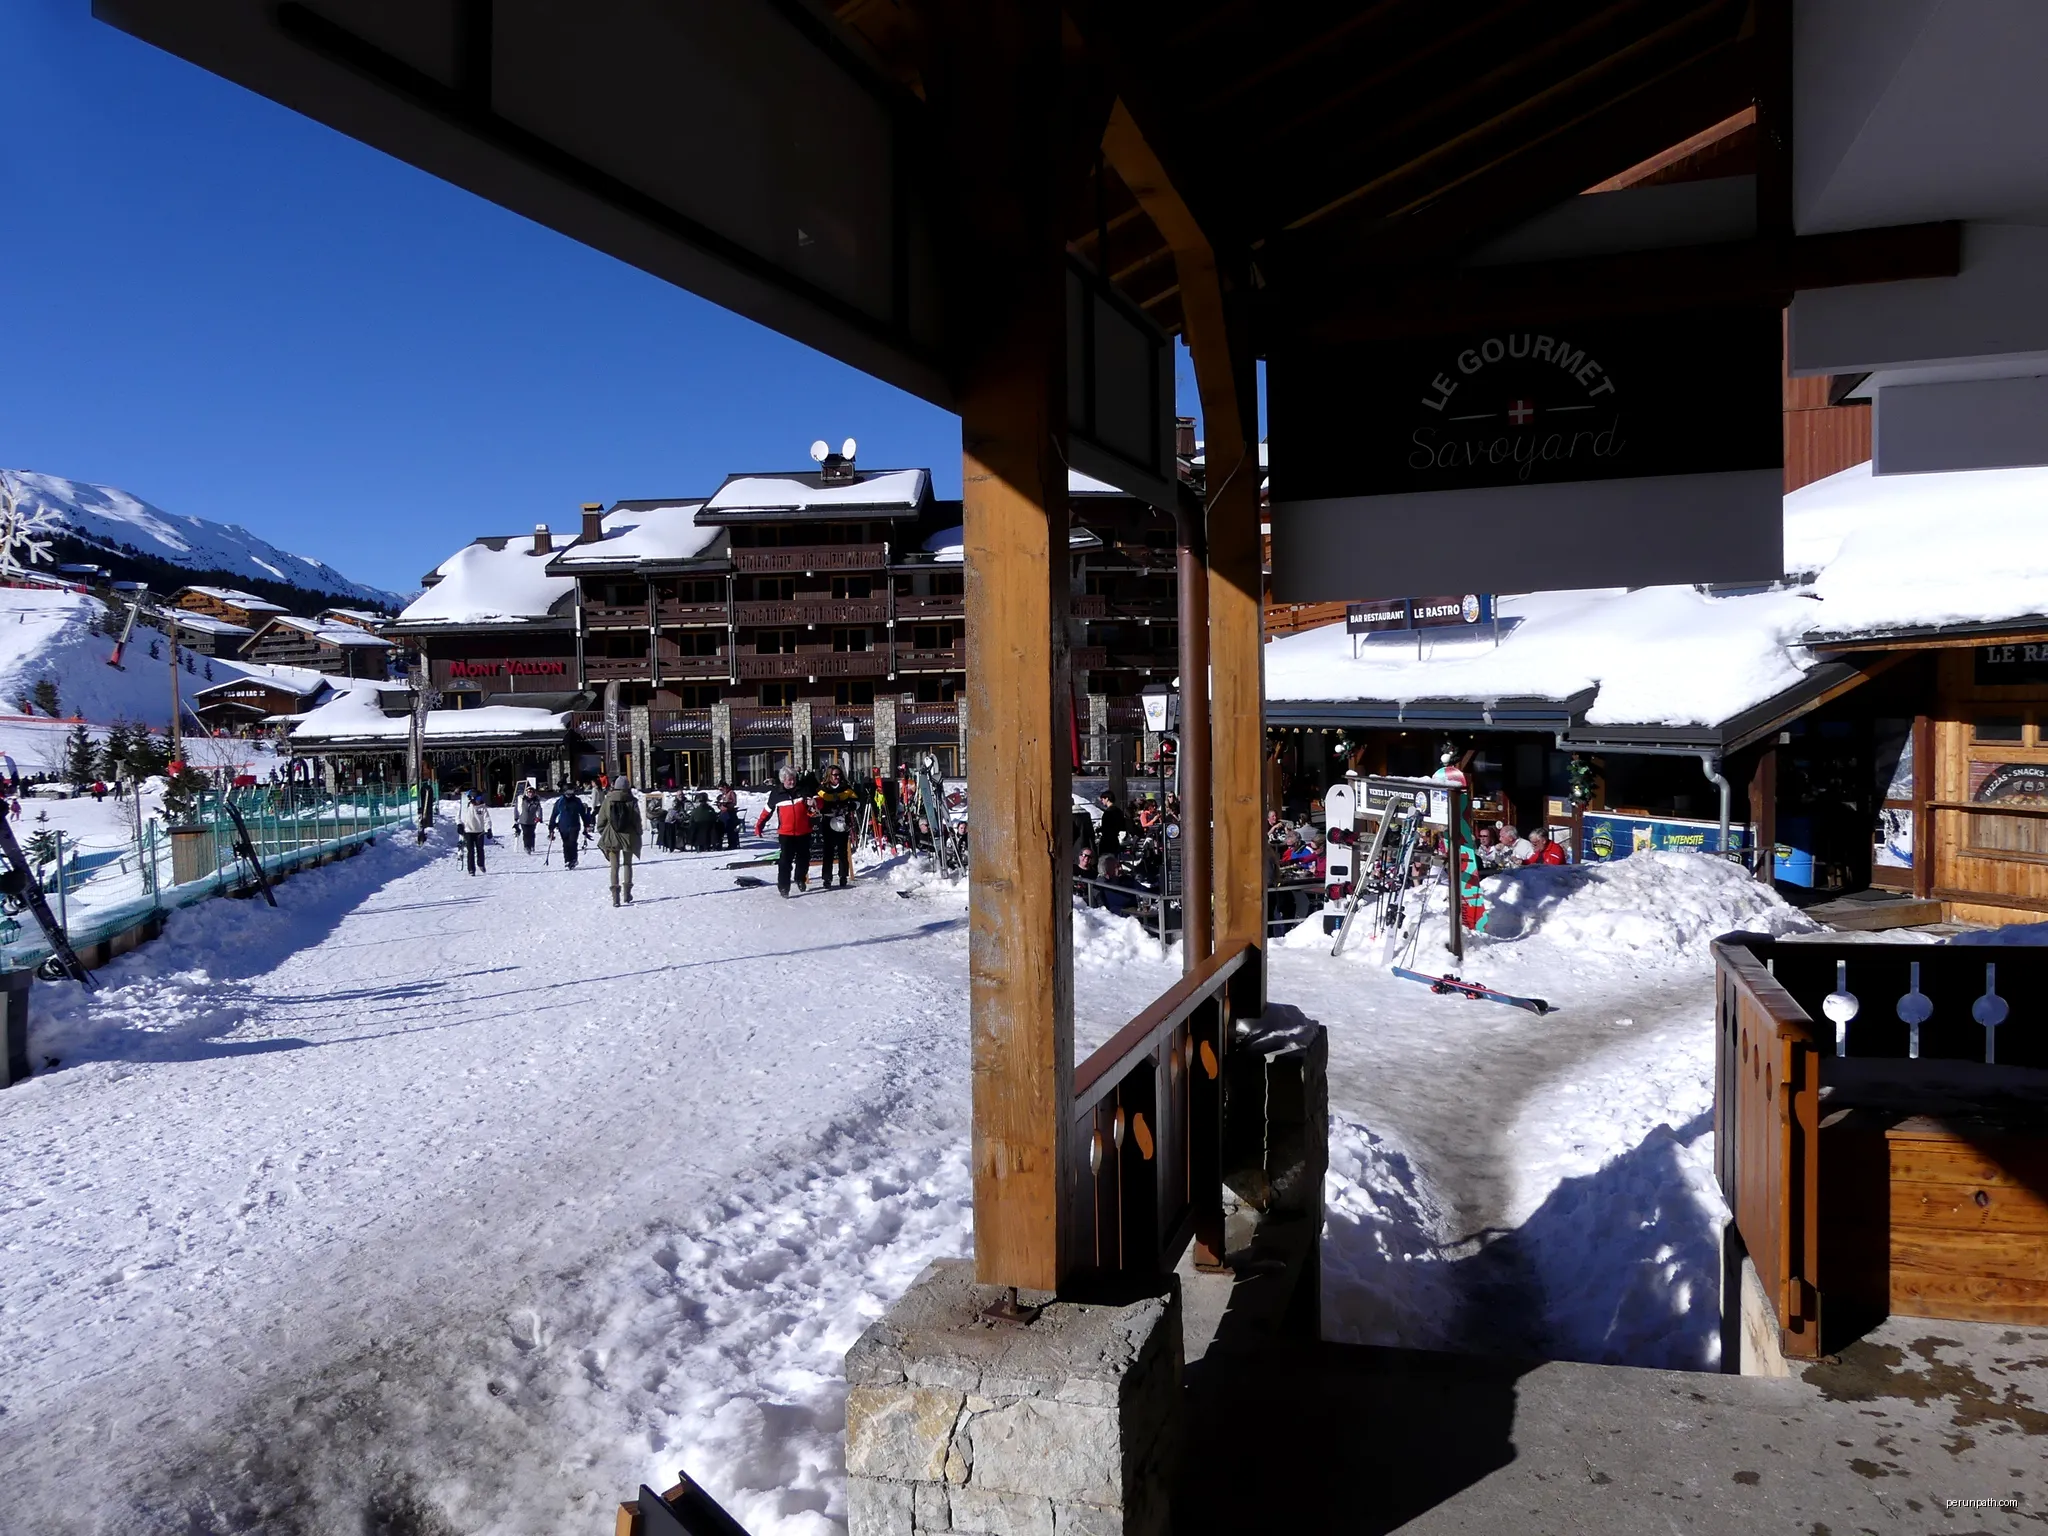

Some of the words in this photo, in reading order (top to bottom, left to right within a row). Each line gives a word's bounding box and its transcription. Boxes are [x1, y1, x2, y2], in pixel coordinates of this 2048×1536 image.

[1421, 371, 1461, 412] LE
[1457, 333, 1616, 398] GOURMET
[1408, 411, 1628, 481] Savoyard
[1350, 614, 1363, 624] BAR
[1363, 610, 1404, 622] RESTAURANT
[1413, 608, 1424, 619] LE
[1425, 604, 1460, 618] RASTRO
[1987, 645, 2016, 664] LE
[449, 660, 499, 677] MONT
[504, 660, 566, 675] VALLON
[1984, 773, 2009, 797] PIZZAS
[2012, 768, 2045, 778] SNACKS
